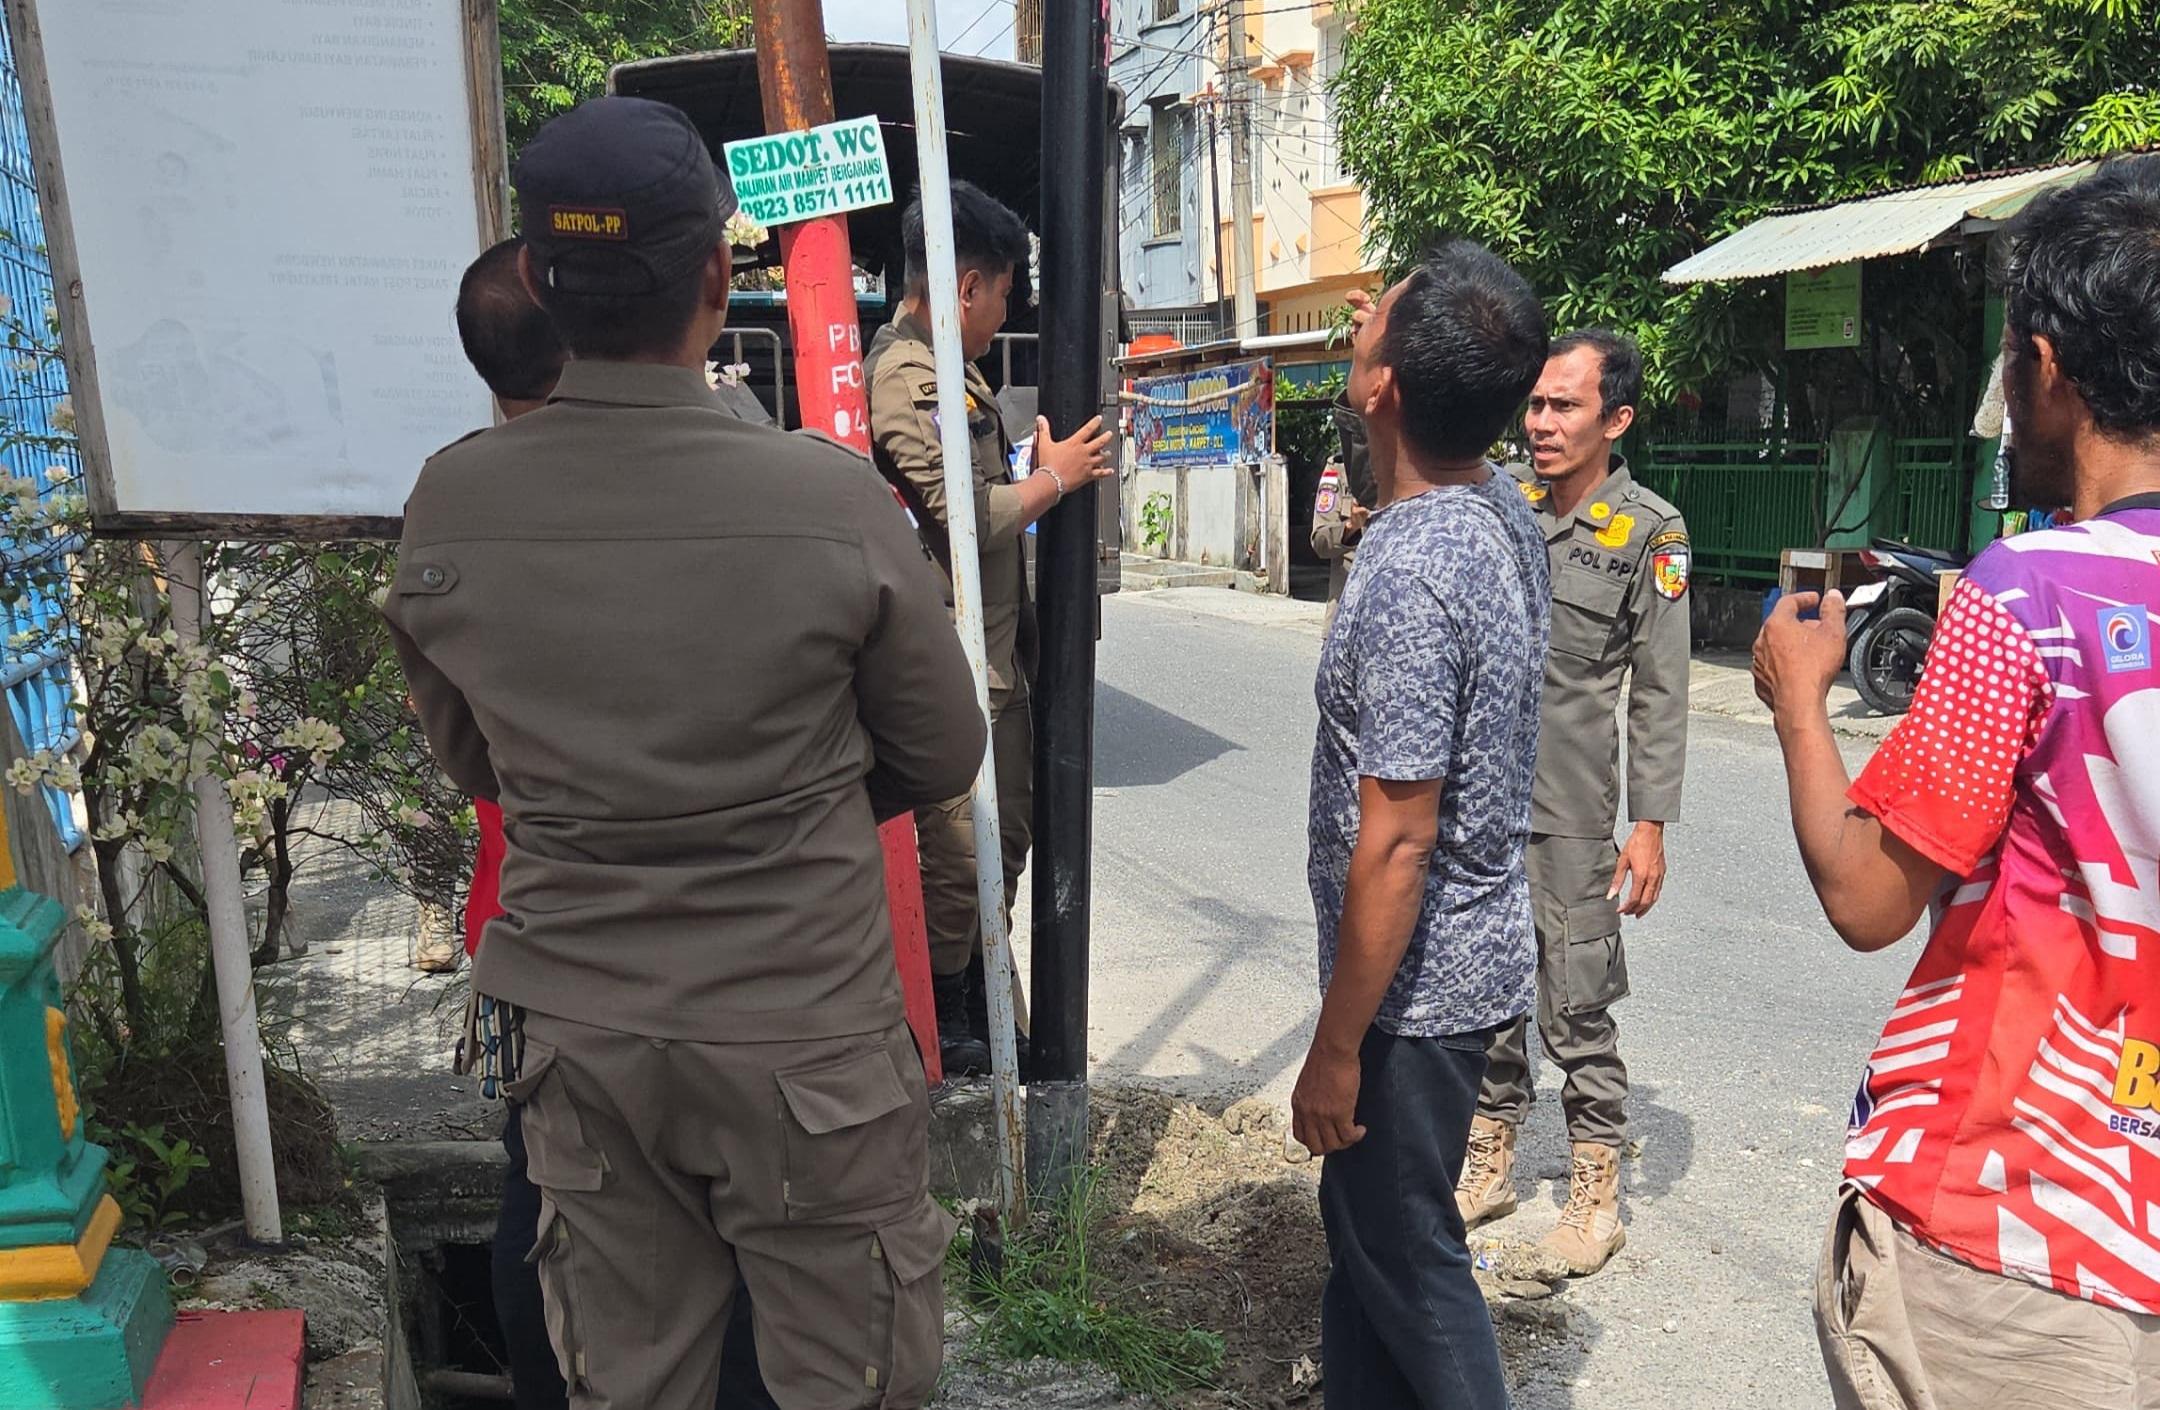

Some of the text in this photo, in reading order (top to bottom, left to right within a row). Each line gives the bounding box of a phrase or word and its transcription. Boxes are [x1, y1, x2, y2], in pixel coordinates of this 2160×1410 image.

[730, 124, 878, 178] SEDOT. WC
[735, 157, 883, 199] SALURAN AIR MAMPET BERGARANSI
[793, 186, 838, 214] 8571
[844, 177, 887, 204] 1111
[553, 211, 621, 233] SATPOL-PP
[1568, 547, 1632, 577] POL PP
